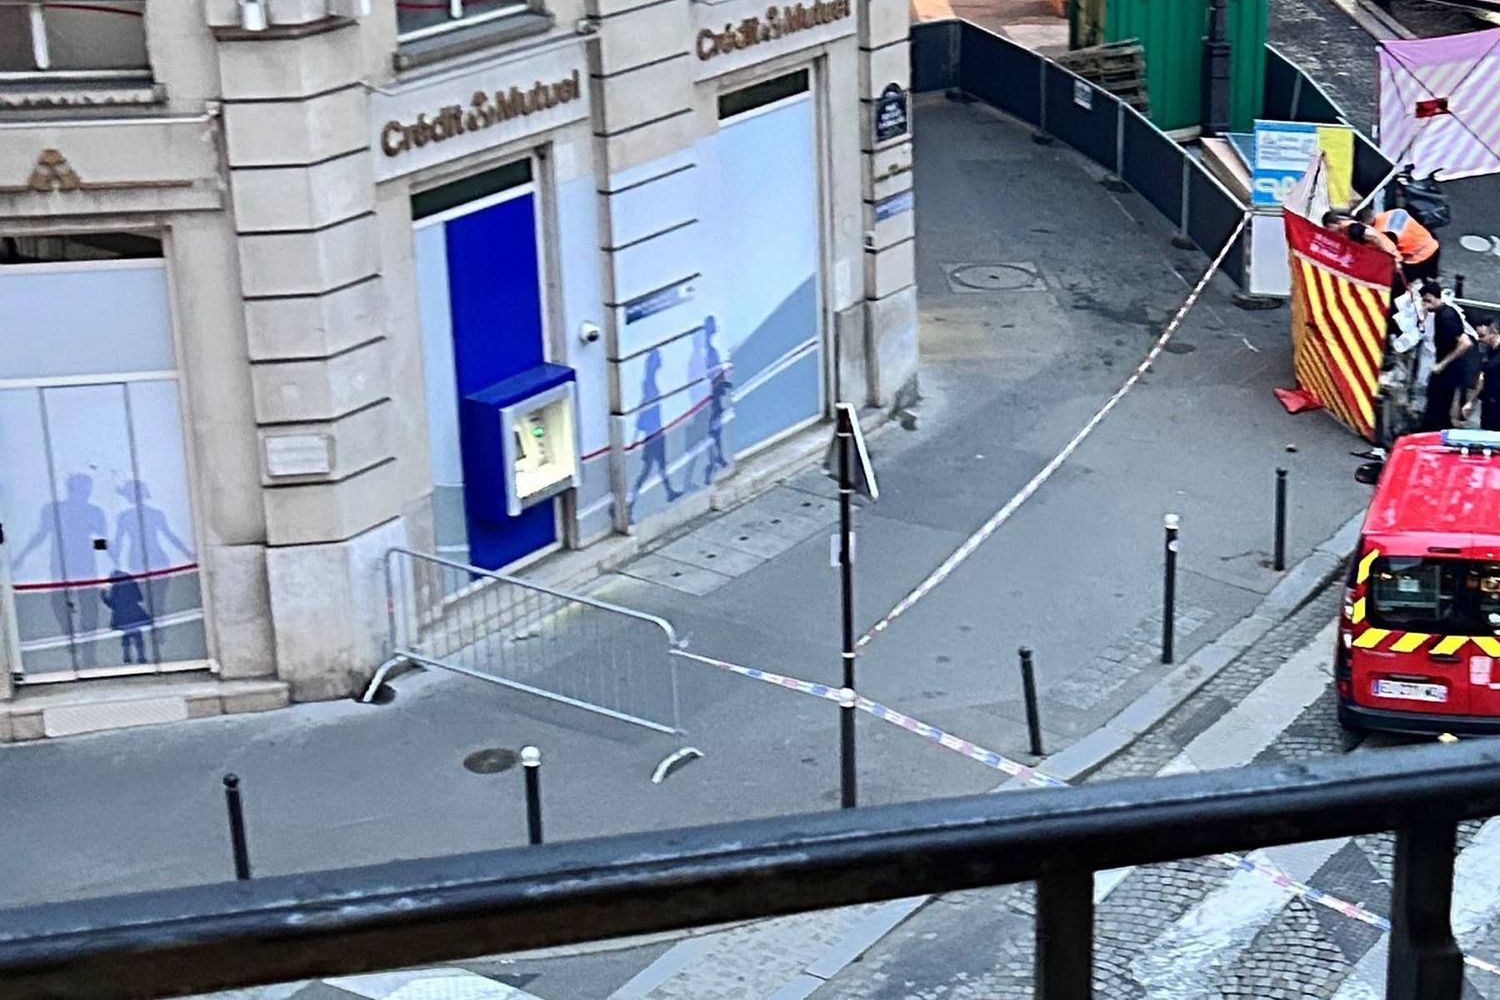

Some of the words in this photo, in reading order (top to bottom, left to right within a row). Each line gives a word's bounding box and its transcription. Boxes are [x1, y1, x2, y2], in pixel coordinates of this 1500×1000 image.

[696, 16, 761, 61] Crédit
[380, 104, 465, 157] Crédit
[494, 69, 580, 121] Mutuel
